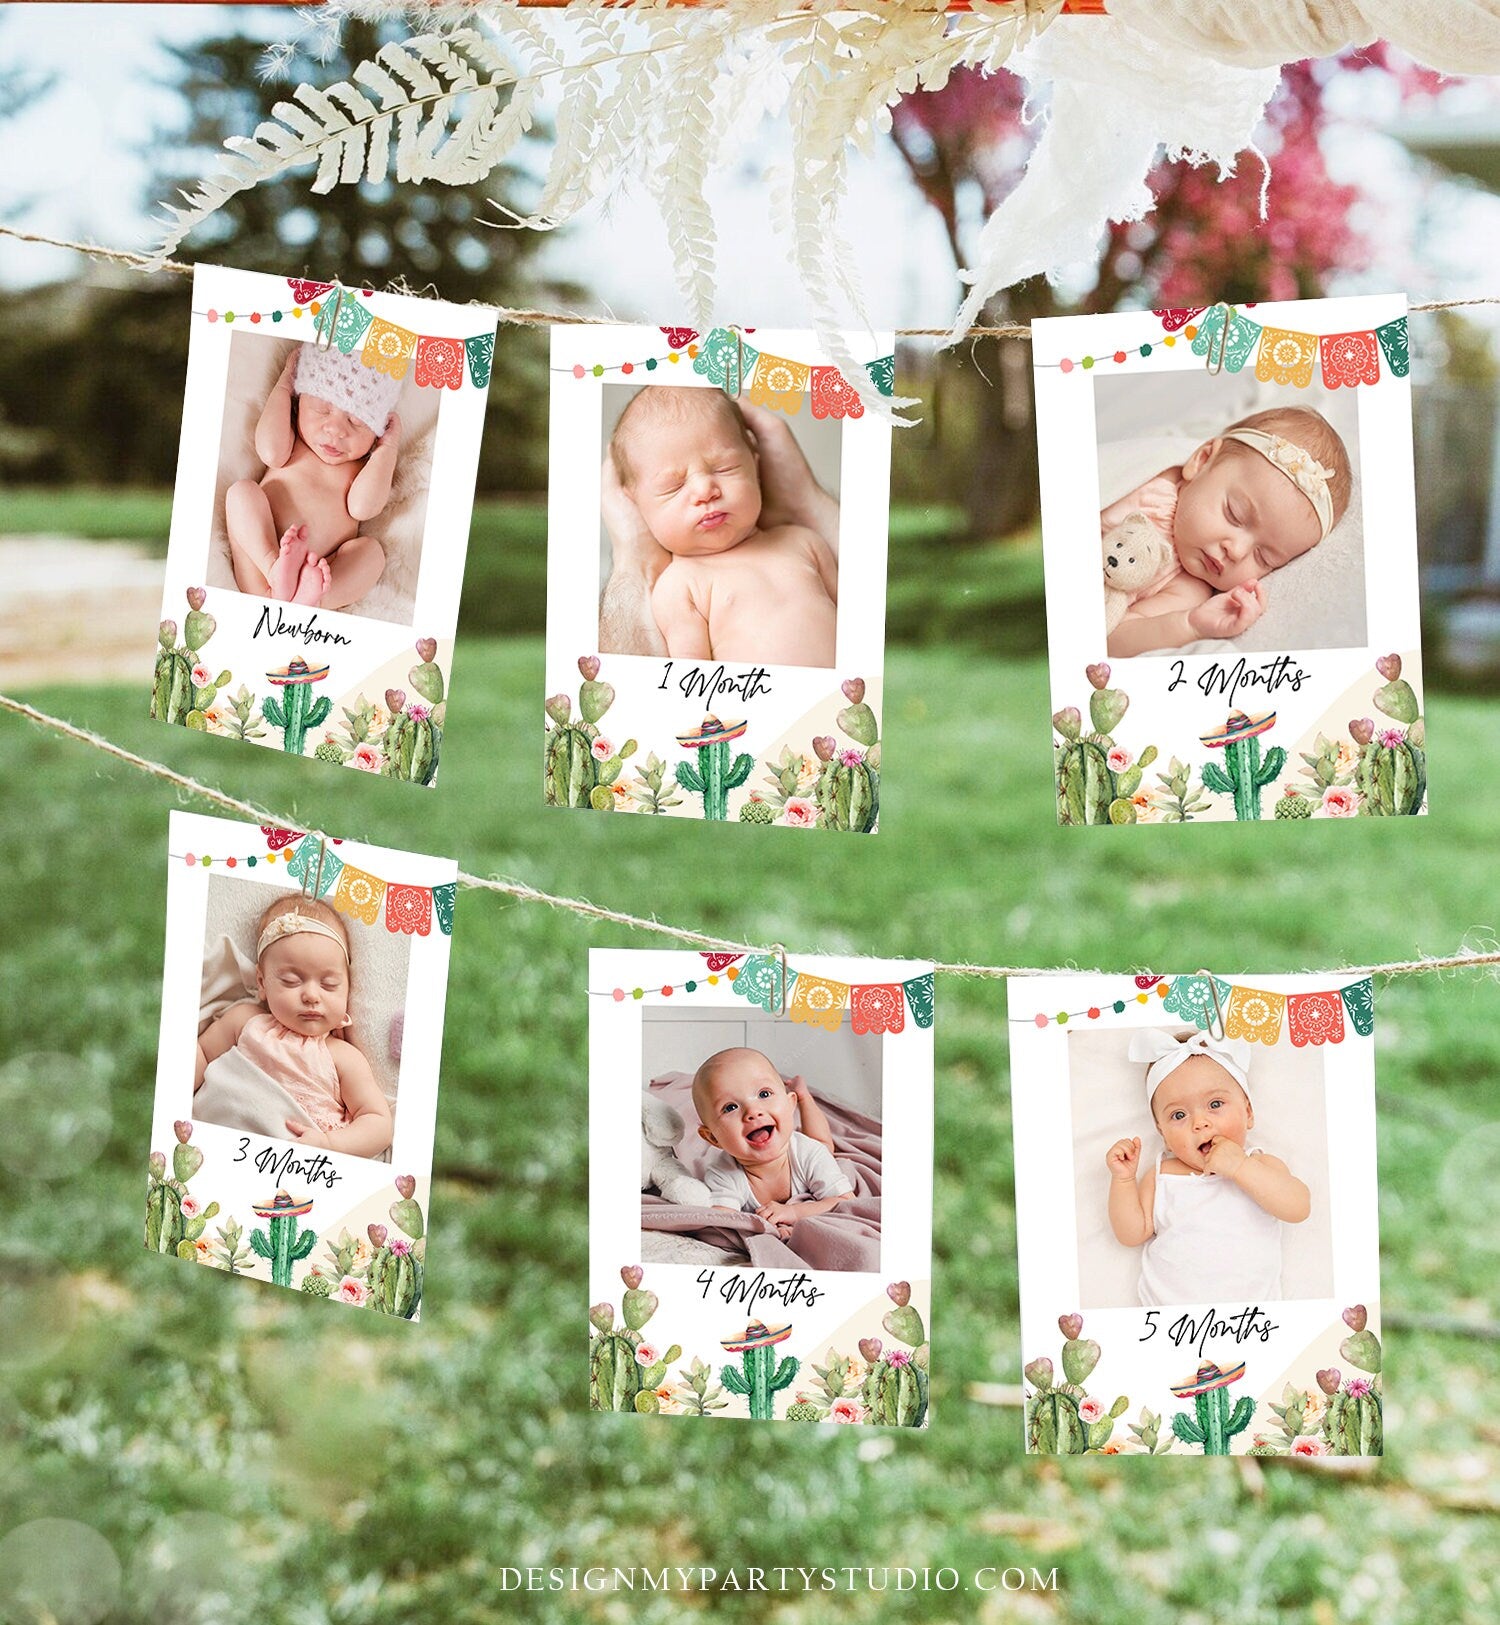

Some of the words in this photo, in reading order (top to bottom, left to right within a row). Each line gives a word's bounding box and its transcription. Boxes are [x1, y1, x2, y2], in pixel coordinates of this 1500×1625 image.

[252, 605, 353, 647] Newborn
[658, 661, 674, 691] 1
[679, 664, 772, 711] Month
[1167, 660, 1189, 692] 2
[1198, 655, 1312, 708] Months
[233, 1137, 251, 1162] 3
[254, 1146, 343, 1189] Months
[696, 1268, 715, 1299] 4
[719, 1270, 825, 1317] Months
[1139, 1311, 1161, 1343] 5
[1167, 1306, 1280, 1358] Months
